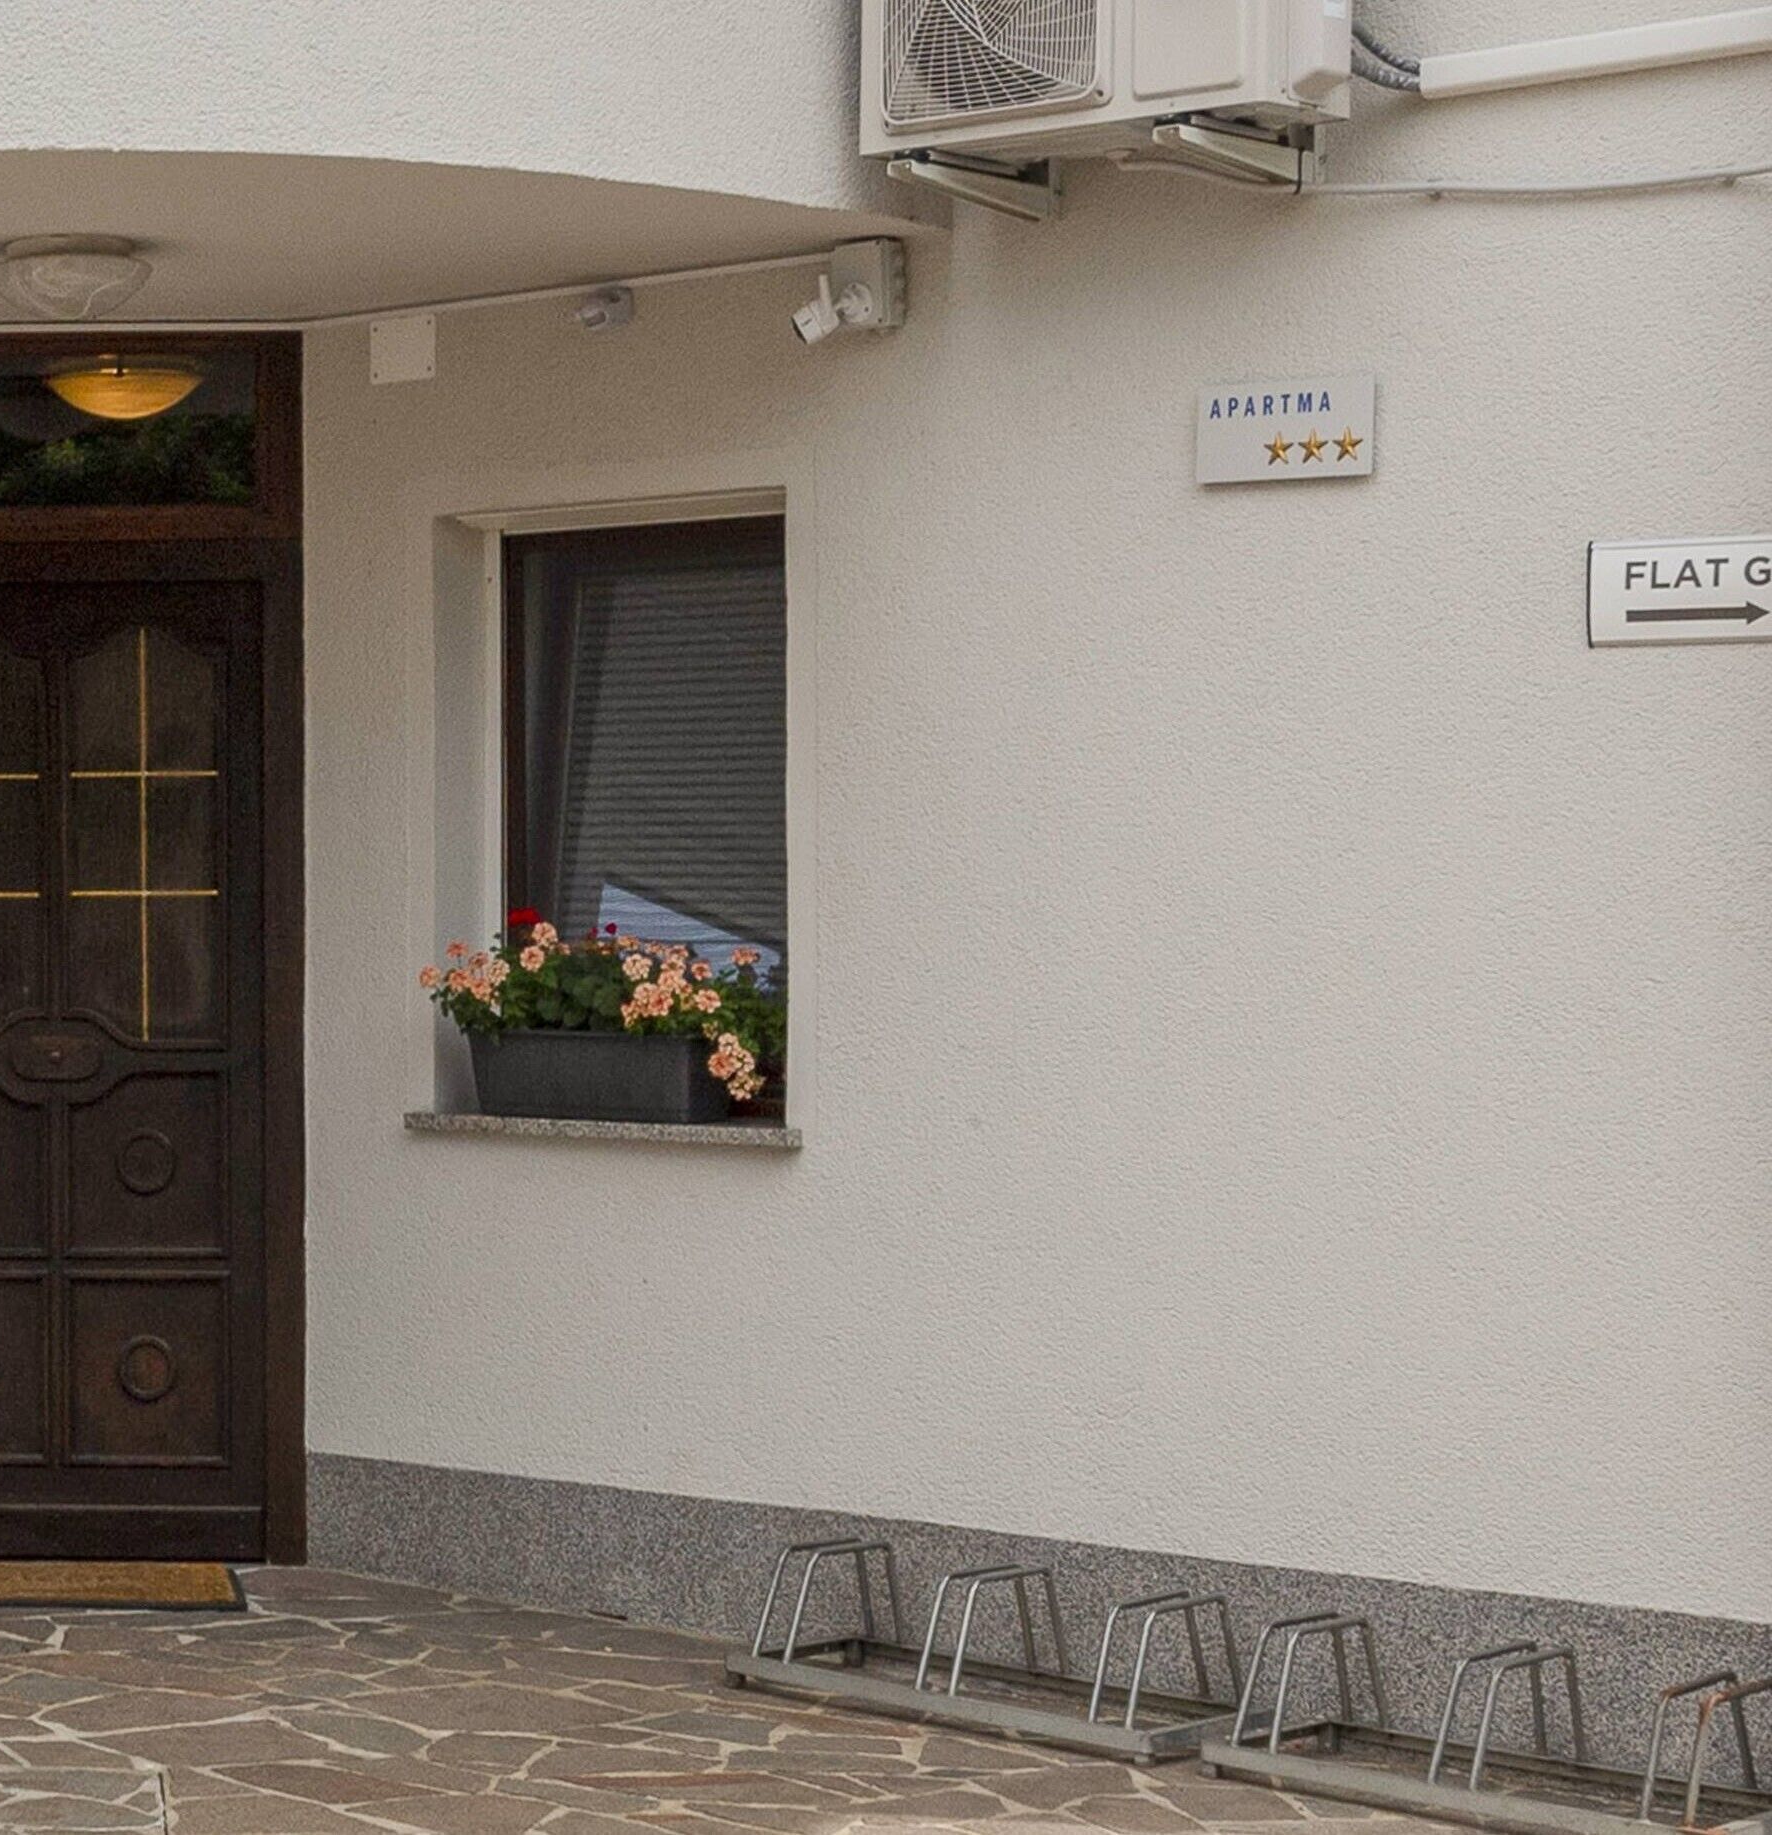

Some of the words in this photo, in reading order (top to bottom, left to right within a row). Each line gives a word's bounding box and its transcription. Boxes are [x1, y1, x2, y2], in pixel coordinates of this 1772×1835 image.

[1209, 391, 1331, 420] APARTMA
[1624, 557, 1730, 590] FLAT
[1743, 556, 1772, 587] G
